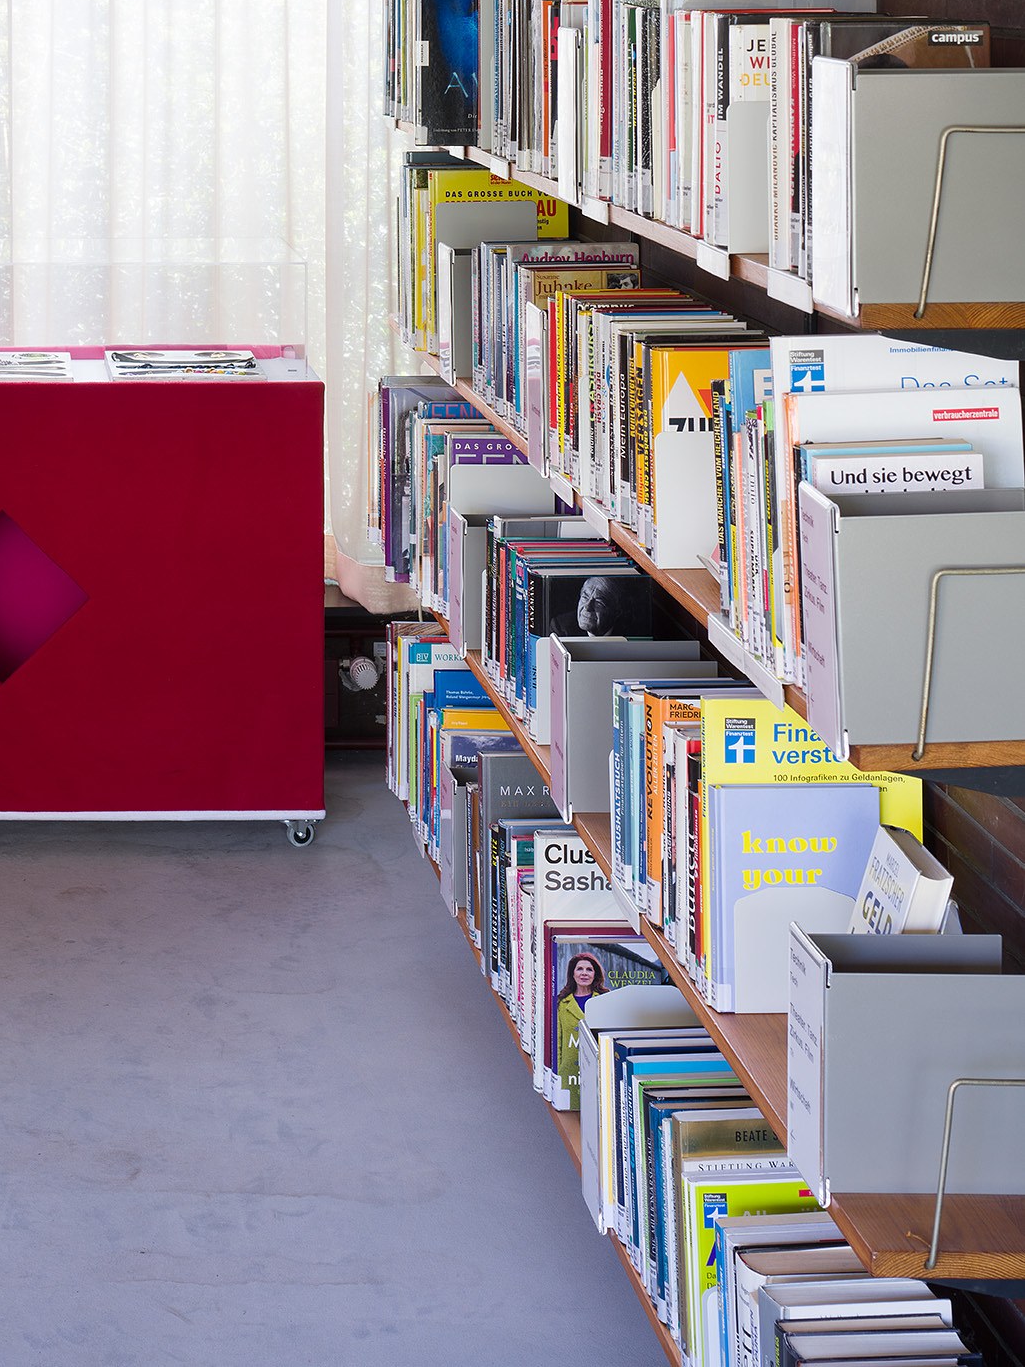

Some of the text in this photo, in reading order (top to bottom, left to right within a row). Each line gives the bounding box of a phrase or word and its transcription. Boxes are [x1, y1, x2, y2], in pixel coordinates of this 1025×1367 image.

[932, 33, 980, 44] campus
[717, 107, 724, 120] IM
[445, 190, 533, 198] DAS GROSSE BUCH
[574, 250, 635, 264] Hepburn
[535, 280, 593, 297] Juhnke
[636, 366, 646, 456] VERSAGEN
[712, 390, 720, 416] LAND
[618, 372, 627, 459] Mein Europa
[934, 410, 998, 420] verbraucherzentrale
[713, 417, 721, 456] REICHEN
[714, 457, 722, 478] VOM
[830, 466, 972, 486] Und sie bewegt
[717, 525, 725, 545] DAS
[669, 703, 694, 711] MARC
[790, 774, 838, 783] Infografiken
[852, 774, 906, 783] Geldanlagen,
[500, 786, 535, 796] MAX
[613, 752, 622, 857] HAUSHALTSBUCH
[741, 830, 837, 854] know
[742, 868, 823, 891] your
[491, 838, 499, 960] LEBENSZEIT REITZ
[862, 890, 892, 934] GELD
[608, 970, 656, 980] CLAUDIA
[610, 979, 653, 987] WENZEL
[735, 1130, 768, 1142] BEATE
[698, 1163, 762, 1172] STIFTUNG
